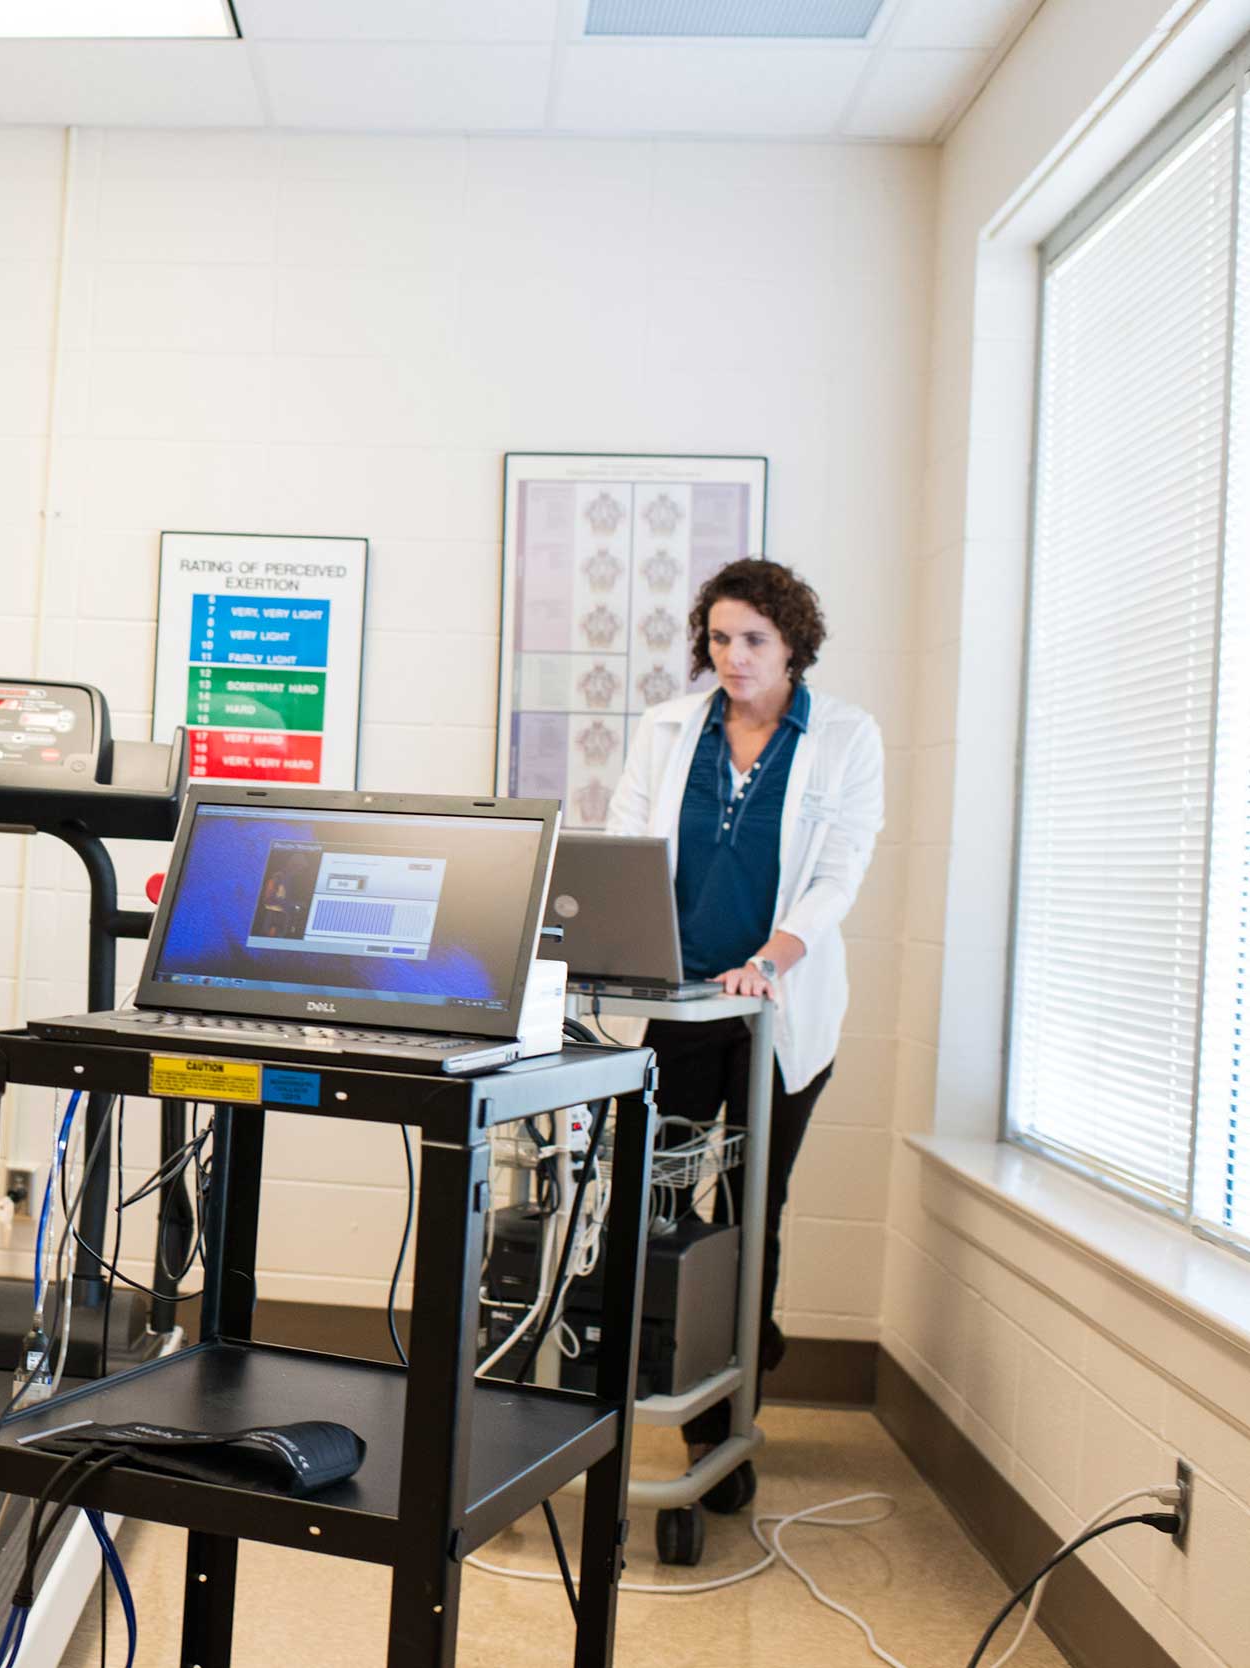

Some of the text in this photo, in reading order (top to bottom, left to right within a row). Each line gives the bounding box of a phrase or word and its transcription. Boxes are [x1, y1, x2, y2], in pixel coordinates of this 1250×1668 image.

[180, 559, 347, 578] RATING OF PERCEIVED
[225, 577, 300, 592] EXERTION
[208, 605, 216, 615] 7
[263, 608, 290, 618] VERY
[292, 609, 324, 620] LIGHT
[229, 629, 258, 640] VERY
[260, 631, 291, 642] LIGHT
[201, 640, 214, 650] 10
[201, 652, 298, 665] 11 FAIRLY LIGHT
[226, 681, 285, 692] SOMEWHAT
[288, 684, 319, 695] HARD
[225, 704, 256, 715] HARD
[195, 731, 284, 745] 17 VERY HARD
[222, 755, 252, 768] VERY,
[253, 758, 281, 768] VERY
[283, 759, 314, 770] HARD
[306, 1001, 337, 1013] DELL
[186, 1061, 225, 1073] CAUTION
